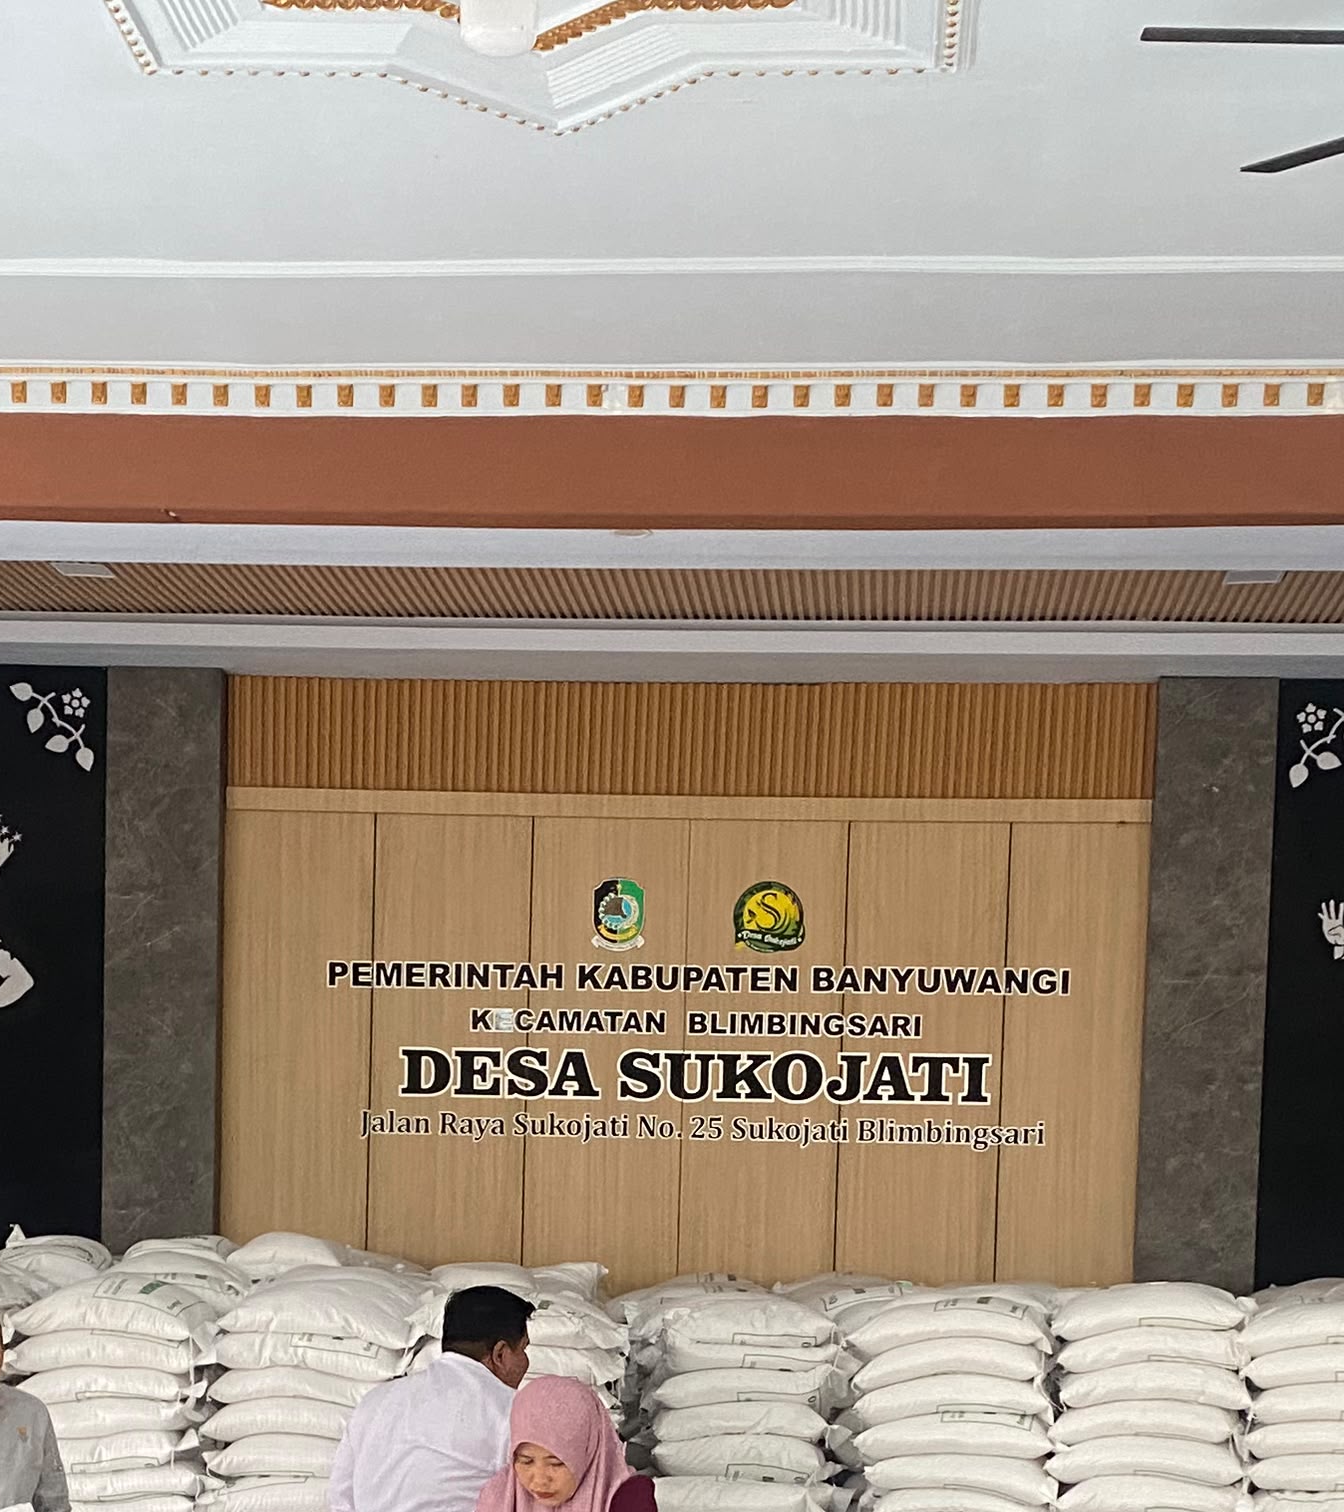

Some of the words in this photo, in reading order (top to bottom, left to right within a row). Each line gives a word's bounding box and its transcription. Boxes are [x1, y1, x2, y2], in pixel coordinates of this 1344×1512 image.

[328, 961, 564, 989] PEMERINTAH
[578, 964, 798, 992] KABUPATEN
[812, 966, 1071, 995] BANYUWANGI
[470, 1008, 666, 1033] KECAMATAN
[687, 1012, 922, 1038] BLIMBINGSARI
[399, 1047, 601, 1098] DESA
[617, 1049, 992, 1105] SUKOJATI
[361, 1110, 430, 1138] Jalan
[439, 1111, 505, 1140] Raya
[513, 1113, 629, 1142] Sukojati
[637, 1115, 684, 1139] No.
[690, 1117, 723, 1139] 25
[730, 1117, 849, 1146] Sukojati
[857, 1119, 1046, 1150] Blimbingsari
